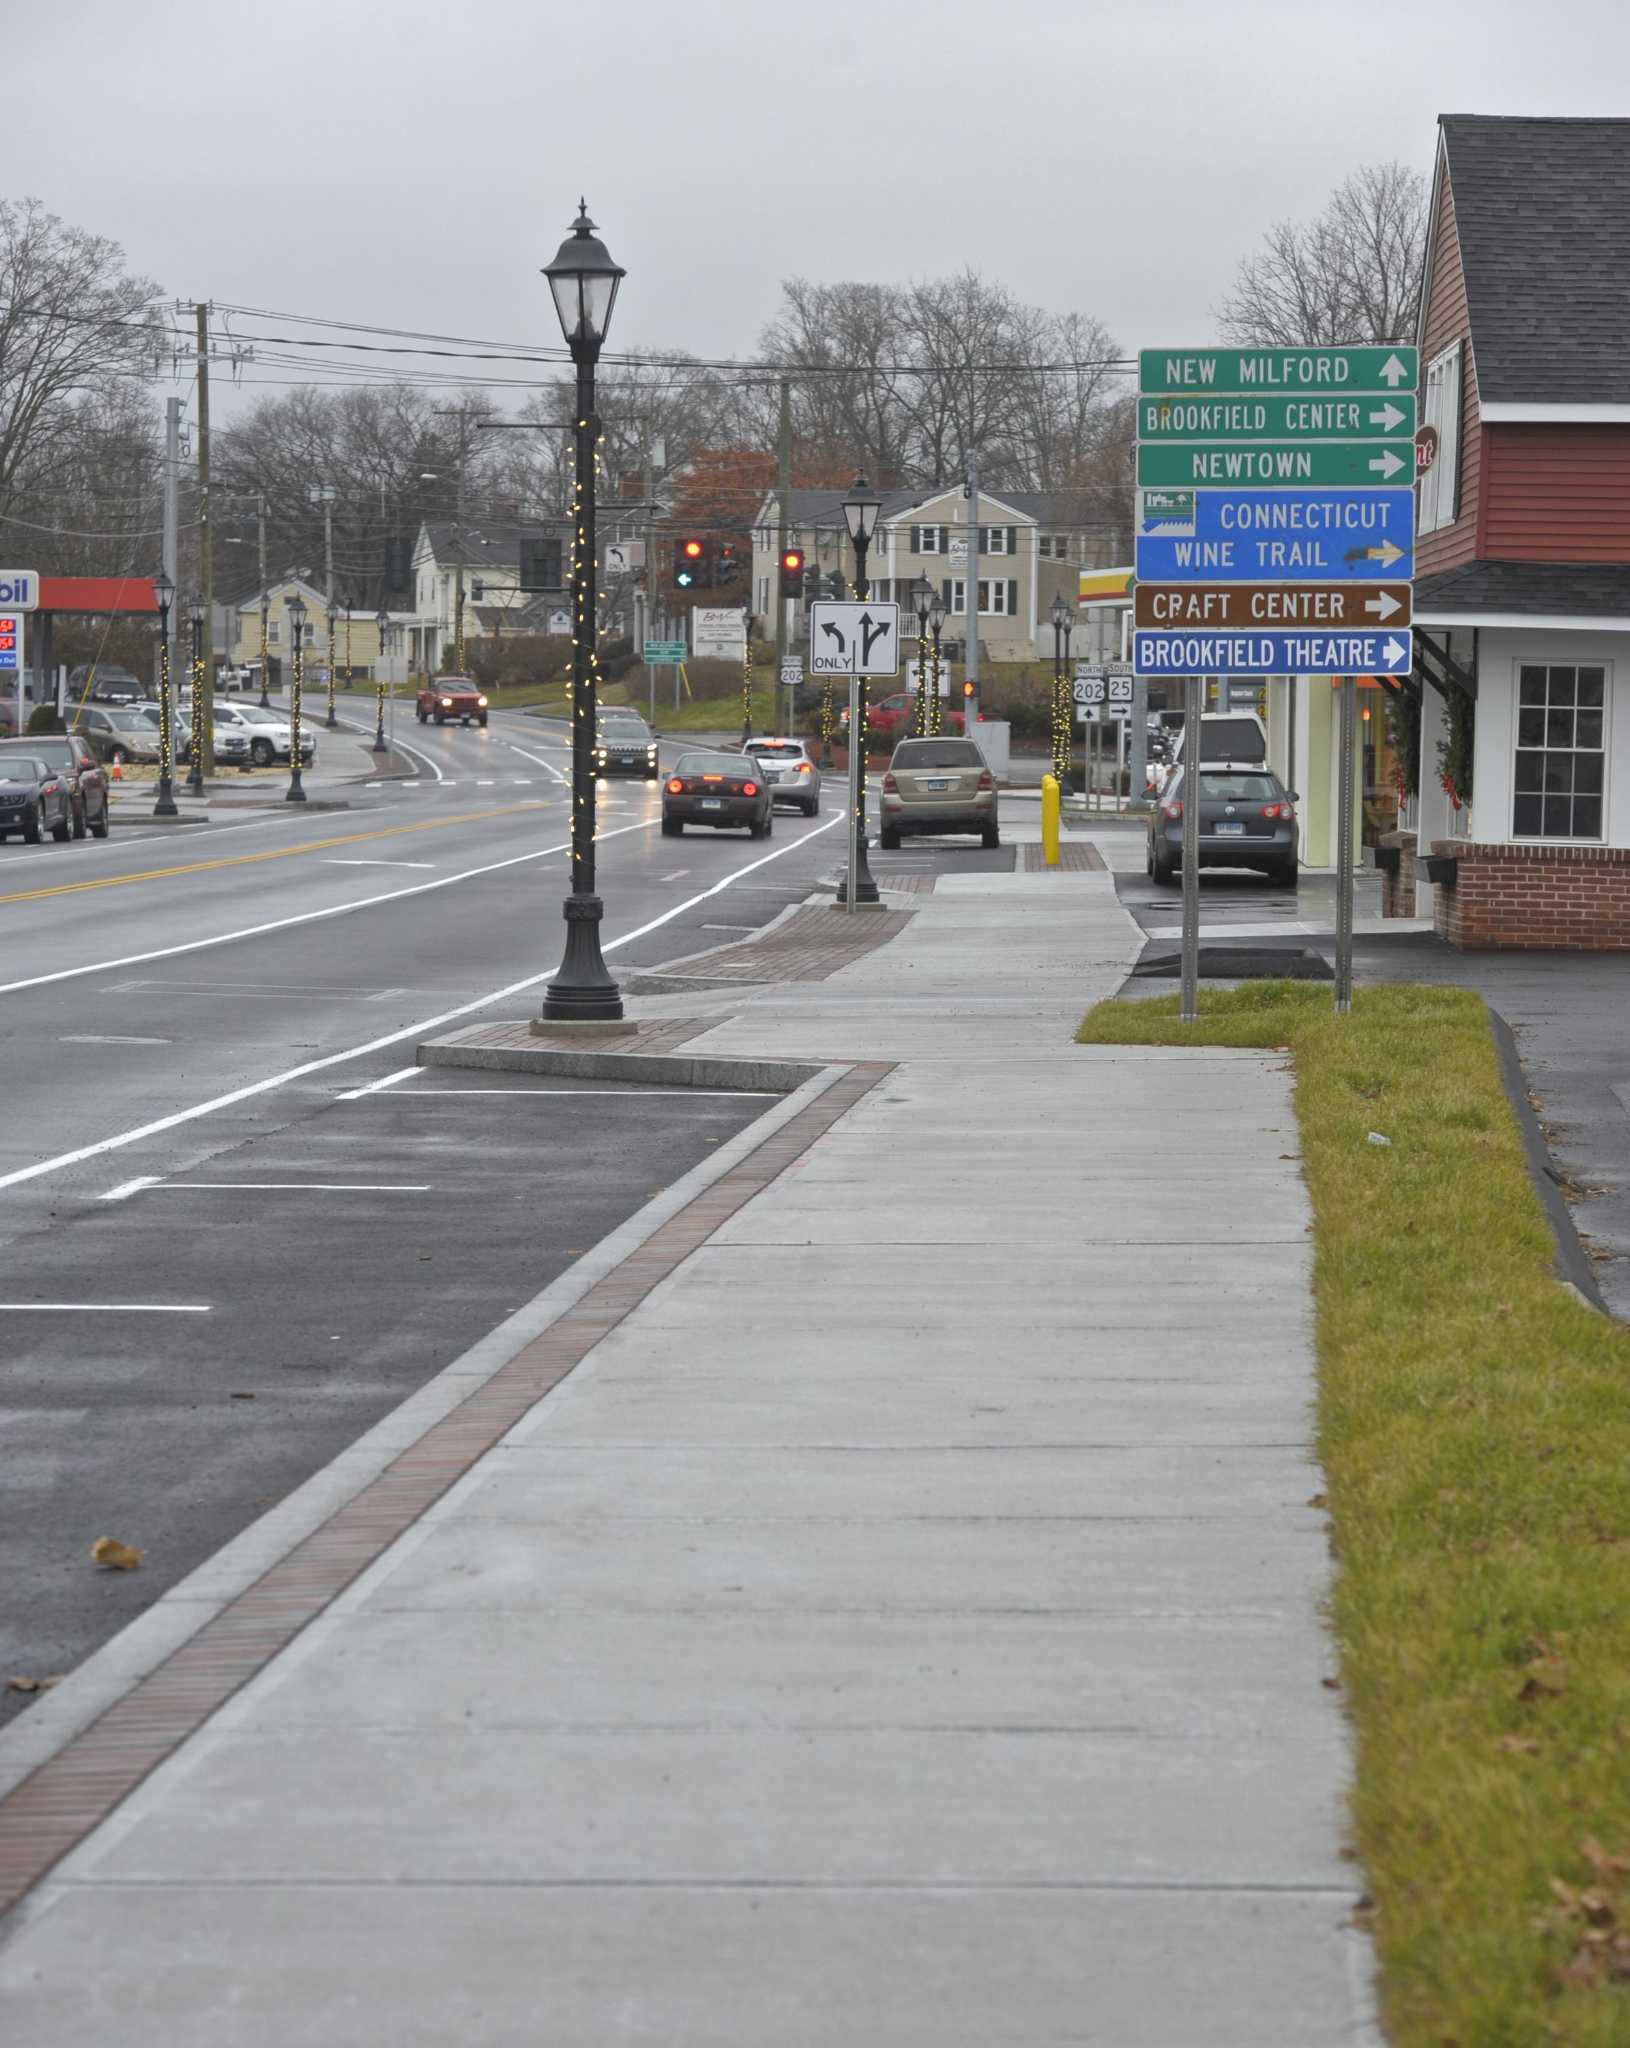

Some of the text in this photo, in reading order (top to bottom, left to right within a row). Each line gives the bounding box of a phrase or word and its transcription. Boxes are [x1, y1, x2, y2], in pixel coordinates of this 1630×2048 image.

[1166, 357, 1349, 384] NEW MILFORD
[1147, 403, 1361, 431] BROOKFIELD CENTER
[1193, 453, 1312, 478] NEWTOWN
[1220, 503, 1391, 529] CONNECTICUT
[1174, 541, 1328, 568] WINE TRAIL
[1251, 592, 1345, 619] CENTER
[815, 657, 852, 669] ONLY
[1141, 638, 1377, 667] BROOKFIELD THEATRE
[783, 670, 802, 681] 202
[1111, 680, 1130, 696] 25
[1075, 683, 1103, 699] 202
